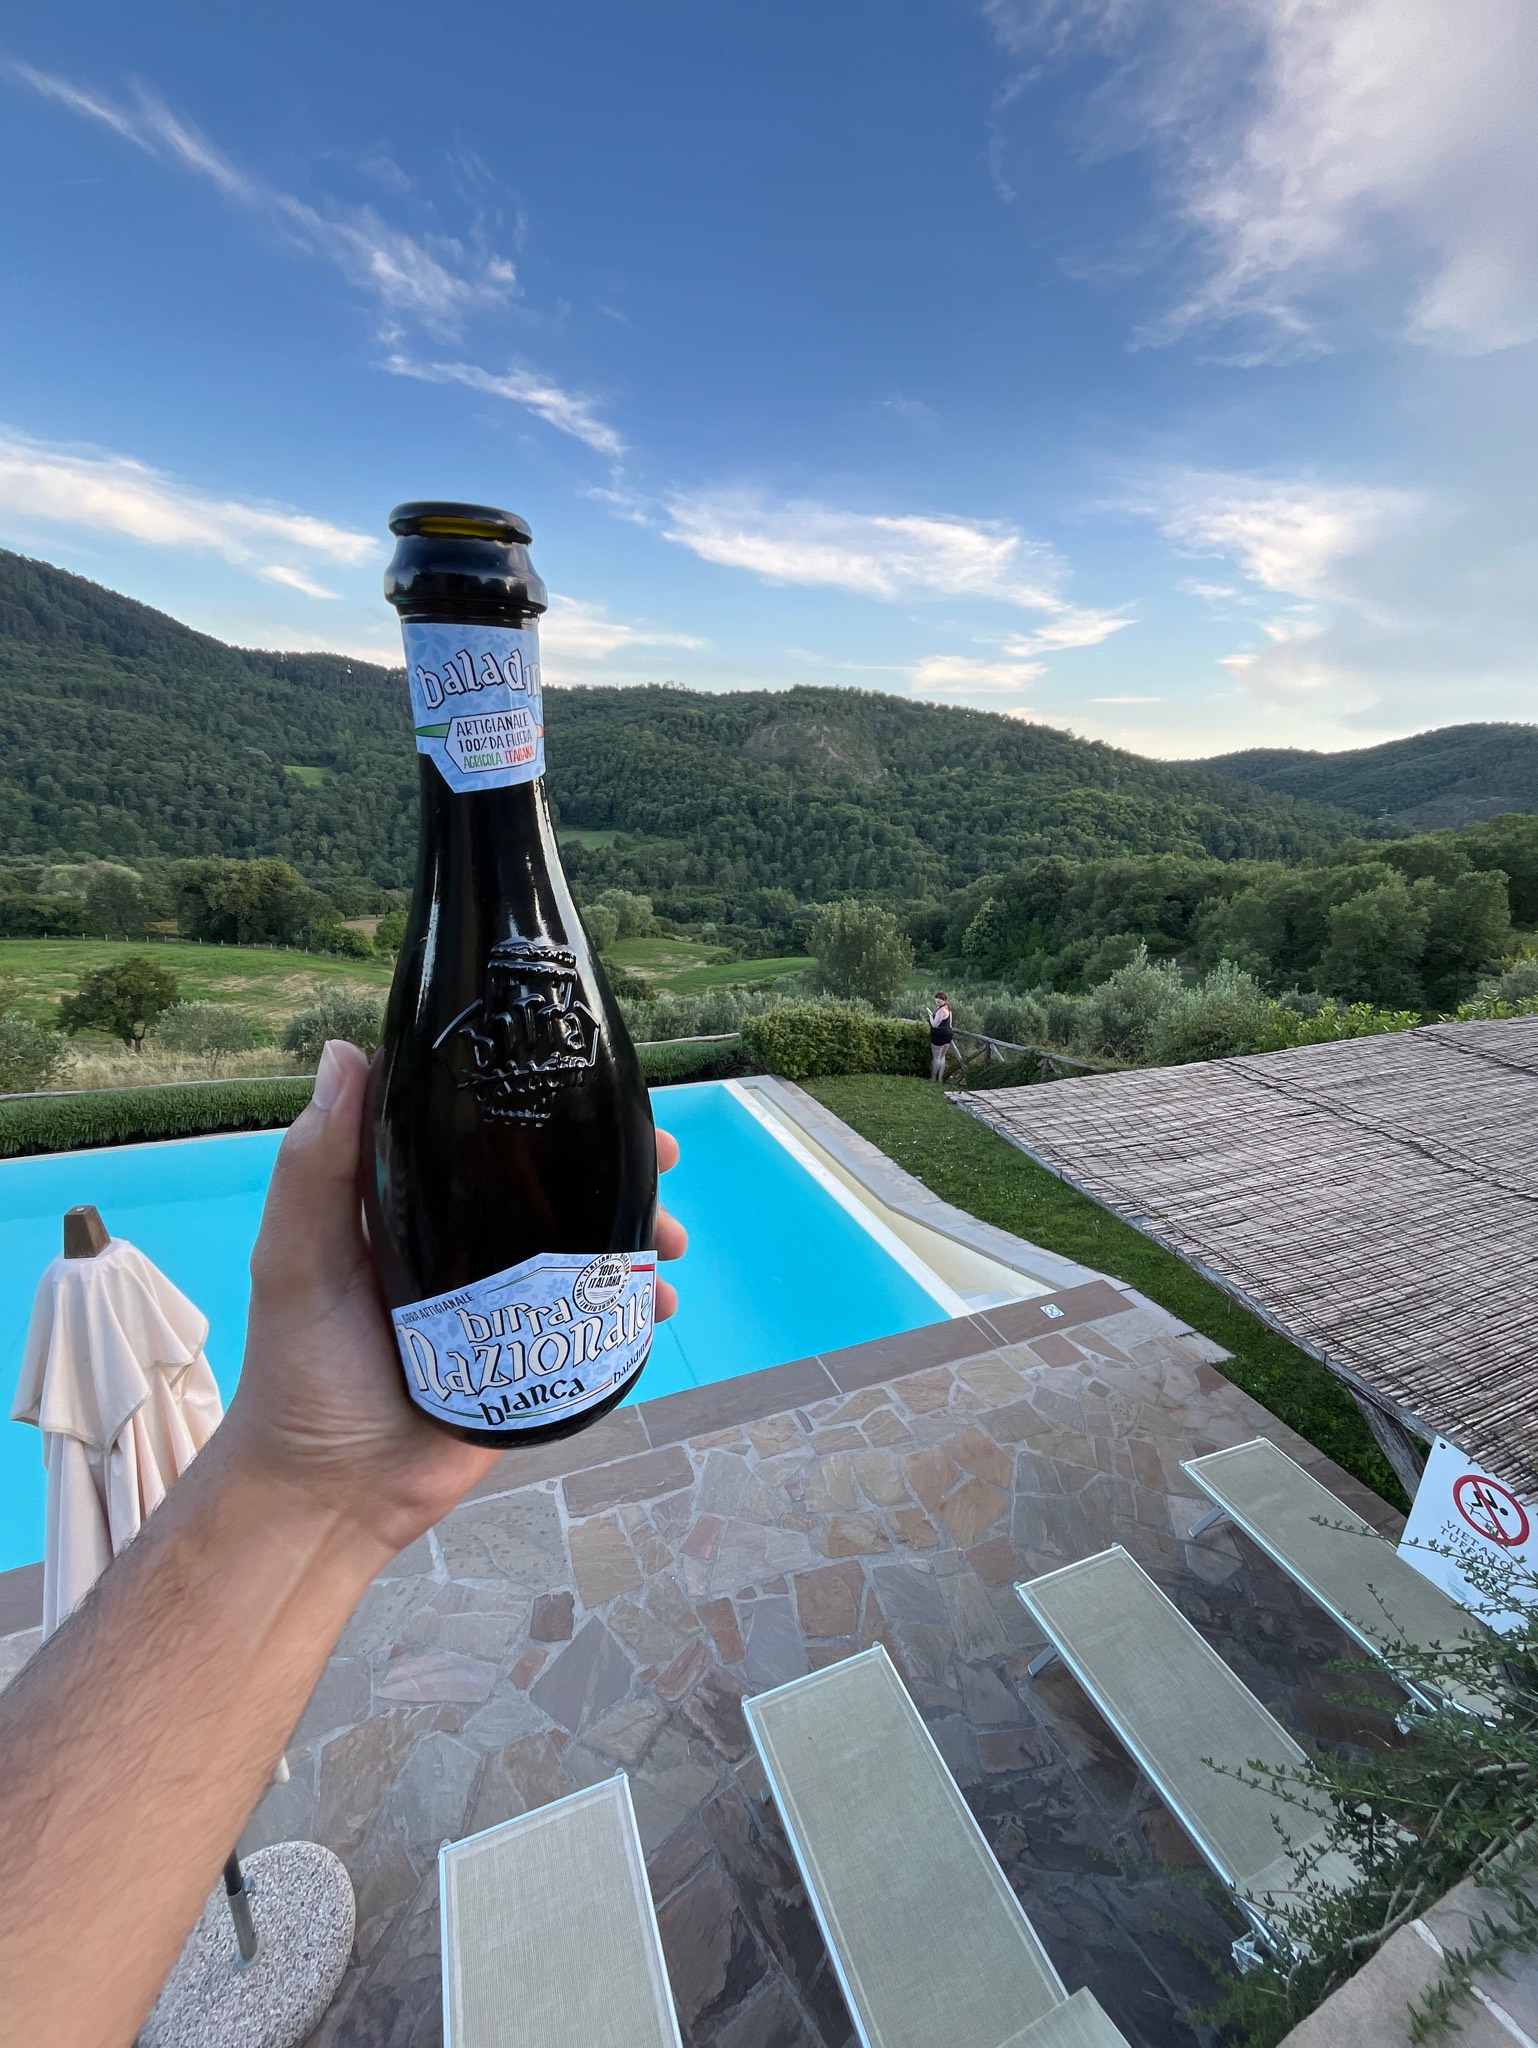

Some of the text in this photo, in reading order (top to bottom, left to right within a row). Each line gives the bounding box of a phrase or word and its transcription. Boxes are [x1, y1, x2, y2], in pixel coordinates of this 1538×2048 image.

[456, 712, 530, 738] ARTIGIANALE
[457, 736, 487, 754] 100%
[490, 734, 504, 749] DA
[463, 745, 535, 770] AGRICOLA ITALIANA
[587, 1275, 622, 1289] ITALIANA
[598, 1264, 622, 1276] 100%
[419, 1291, 475, 1320] ARTIGIANALE
[456, 1297, 574, 1343] birra
[613, 1343, 645, 1385] baladin
[1446, 1519, 1510, 1571] VIETATO
